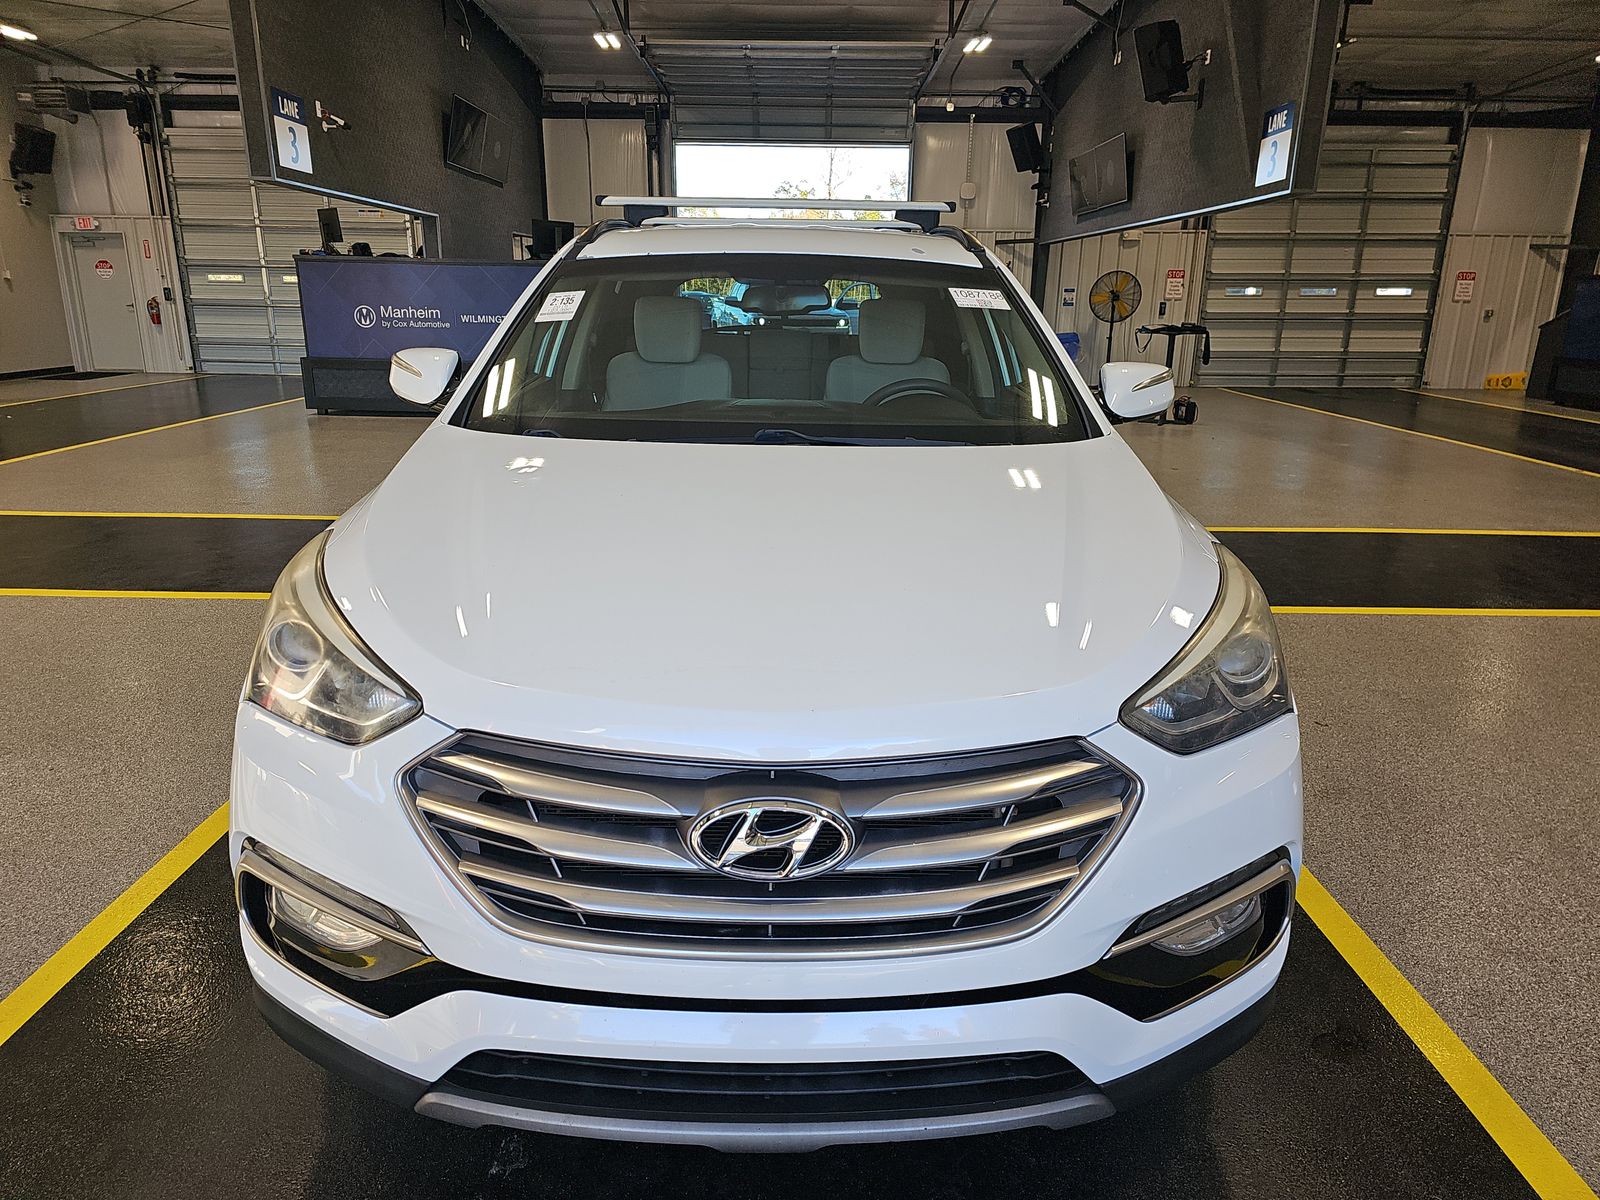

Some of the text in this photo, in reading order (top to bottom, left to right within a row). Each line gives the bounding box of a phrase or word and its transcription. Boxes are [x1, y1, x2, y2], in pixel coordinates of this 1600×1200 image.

[278, 95, 300, 119] LANE
[1267, 110, 1288, 133] LANE
[288, 126, 299, 164] 3
[1266, 140, 1278, 177] 3
[1168, 270, 1185, 278] STOP
[1458, 272, 1476, 280] STOP
[953, 290, 1004, 300] 1087188
[380, 305, 441, 319] Manheim
[381, 320, 451, 329] by Cox Automotive
